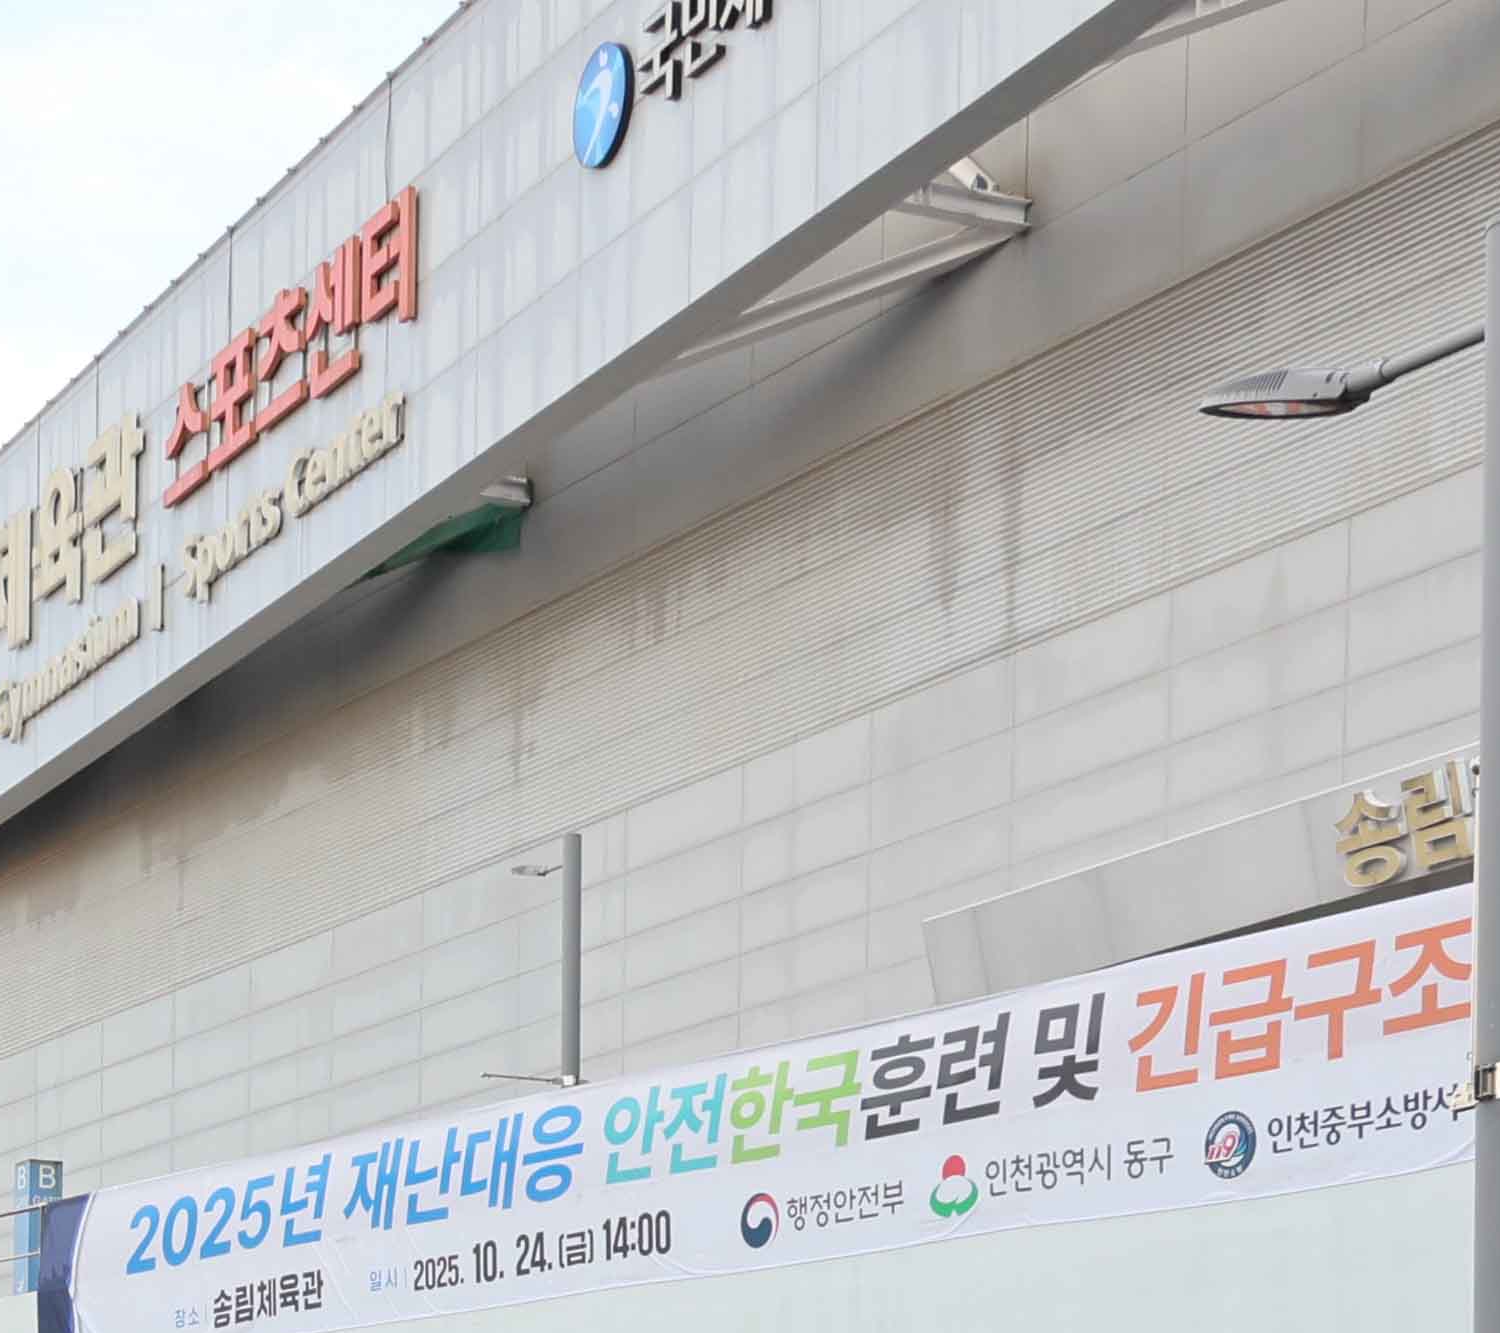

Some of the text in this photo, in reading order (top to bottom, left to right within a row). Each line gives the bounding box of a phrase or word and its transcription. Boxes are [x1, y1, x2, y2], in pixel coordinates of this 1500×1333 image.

[163, 184, 418, 507] 스포츠센터
[183, 390, 406, 602] Sports Center
[39, 1164, 56, 1189] B
[125, 1154, 333, 1276] 2025년
[343, 1103, 585, 1232] 재난대응
[602, 1011, 1012, 1187] 안전한국훈련
[1032, 991, 1106, 1109] 및
[785, 1136, 1176, 1233] 행정안전부 인천광역시 동구
[369, 1269, 399, 1292] 일시
[413, 1257, 465, 1292] 2025.
[472, 1240, 504, 1284] 10.
[602, 1209, 672, 1263] 14:00
[174, 1270, 325, 1330] 장소 송림체육관
